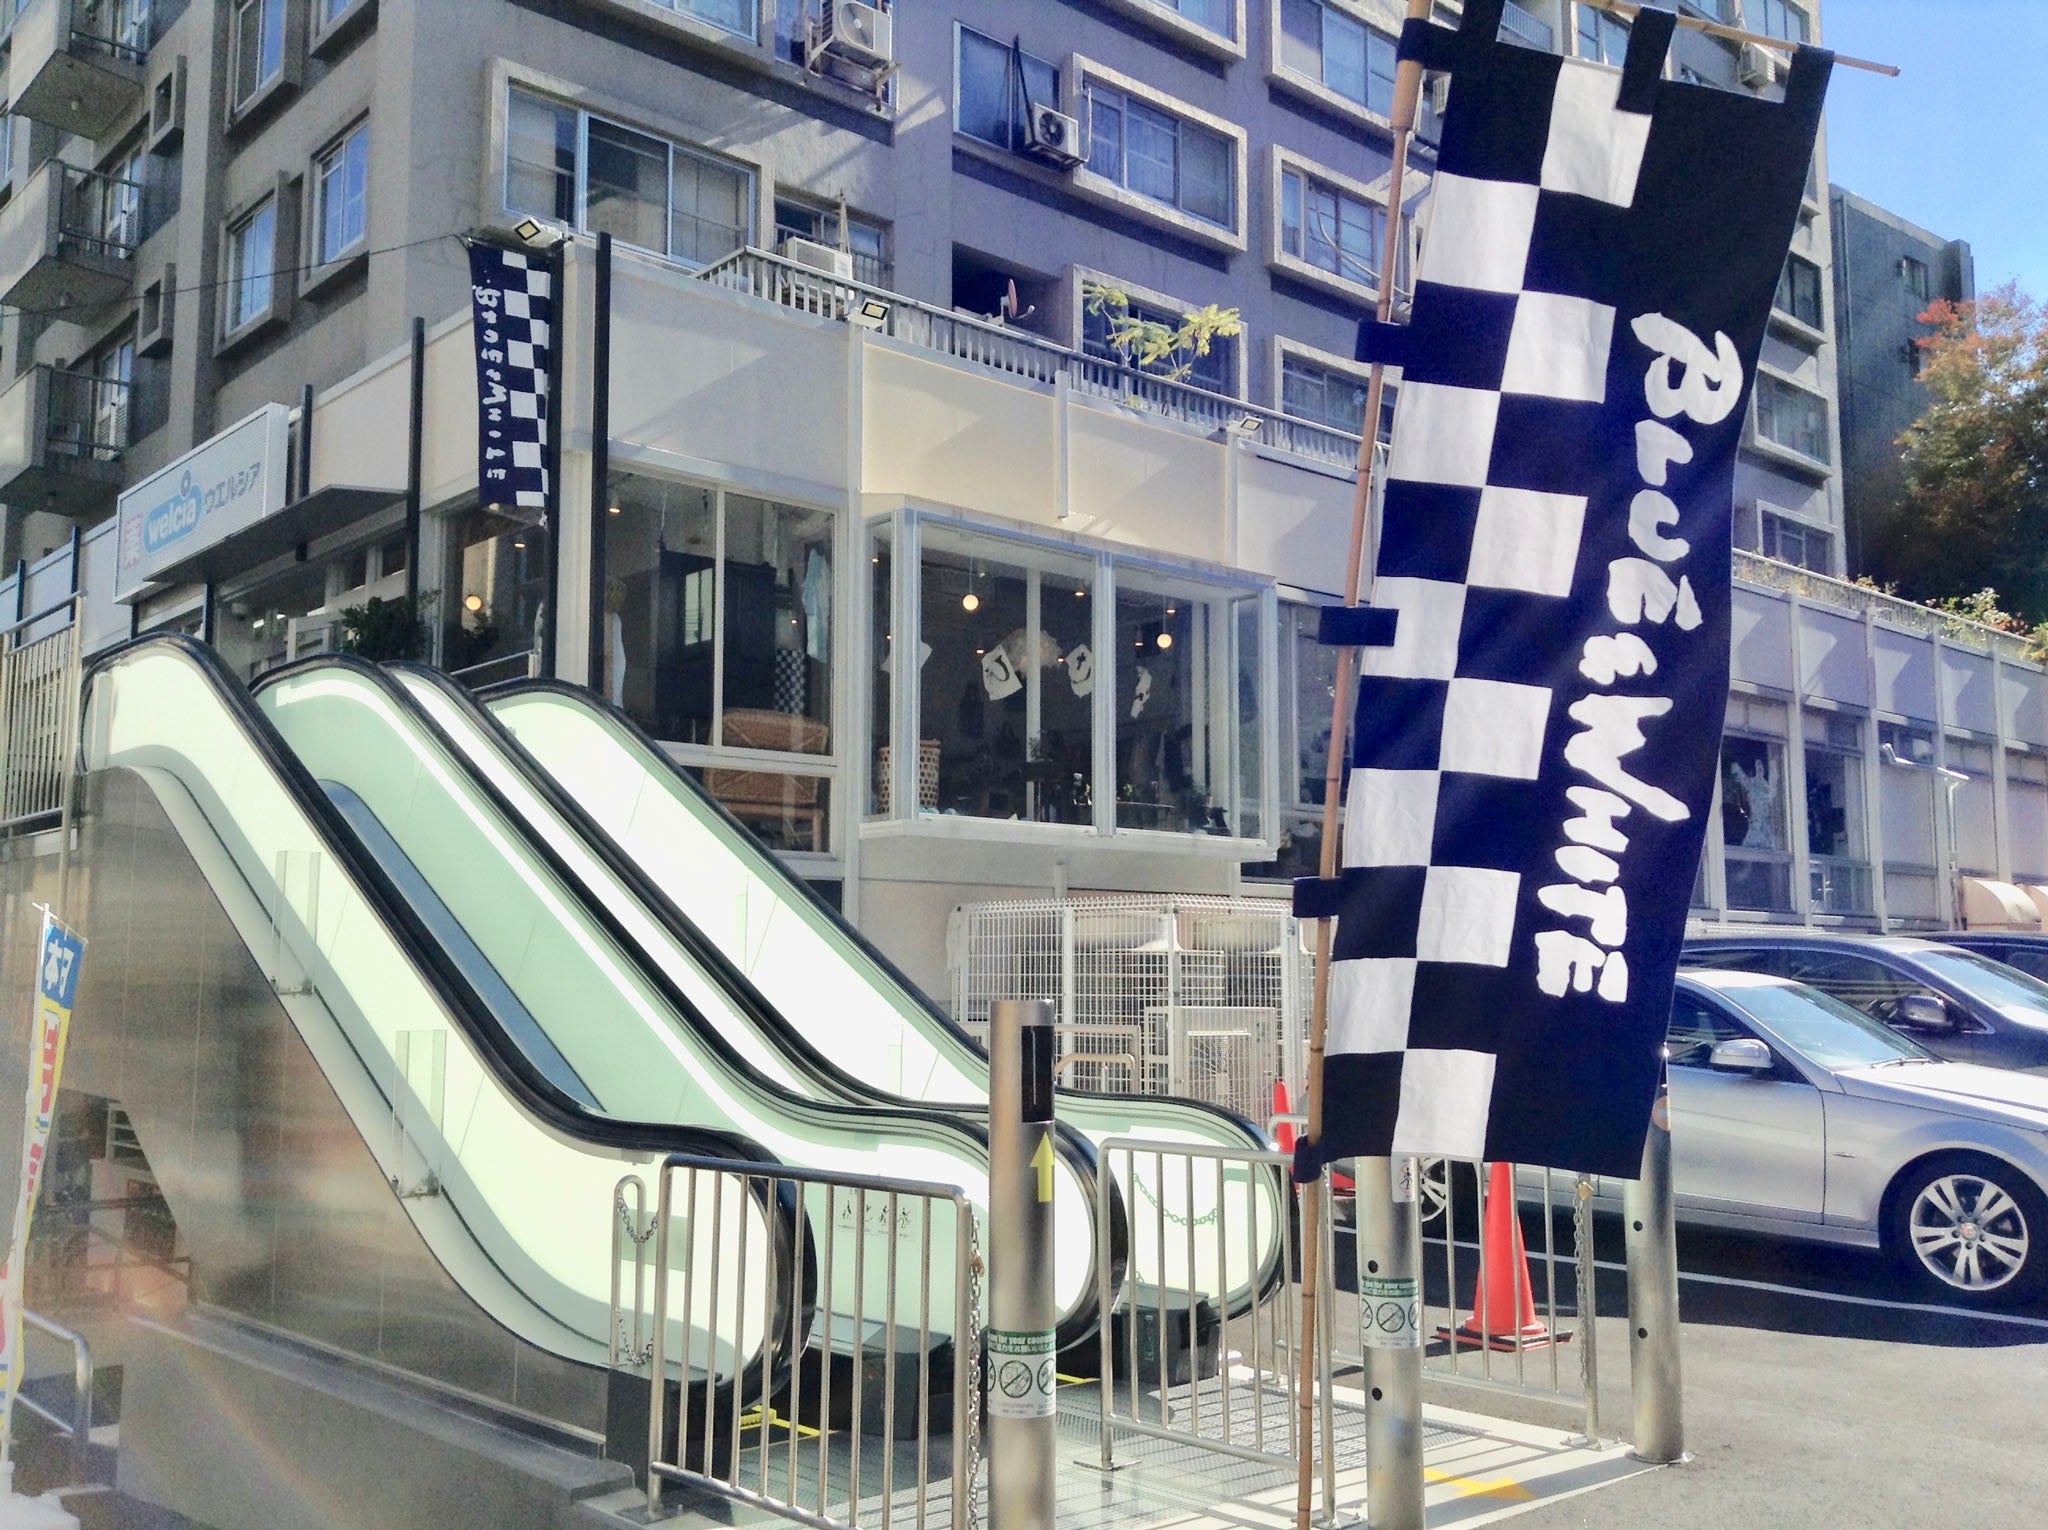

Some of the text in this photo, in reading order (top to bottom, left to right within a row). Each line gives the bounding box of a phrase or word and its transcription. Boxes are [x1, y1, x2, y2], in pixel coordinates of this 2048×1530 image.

[148, 498, 197, 545] welcia
[204, 461, 261, 515] ウエルシア
